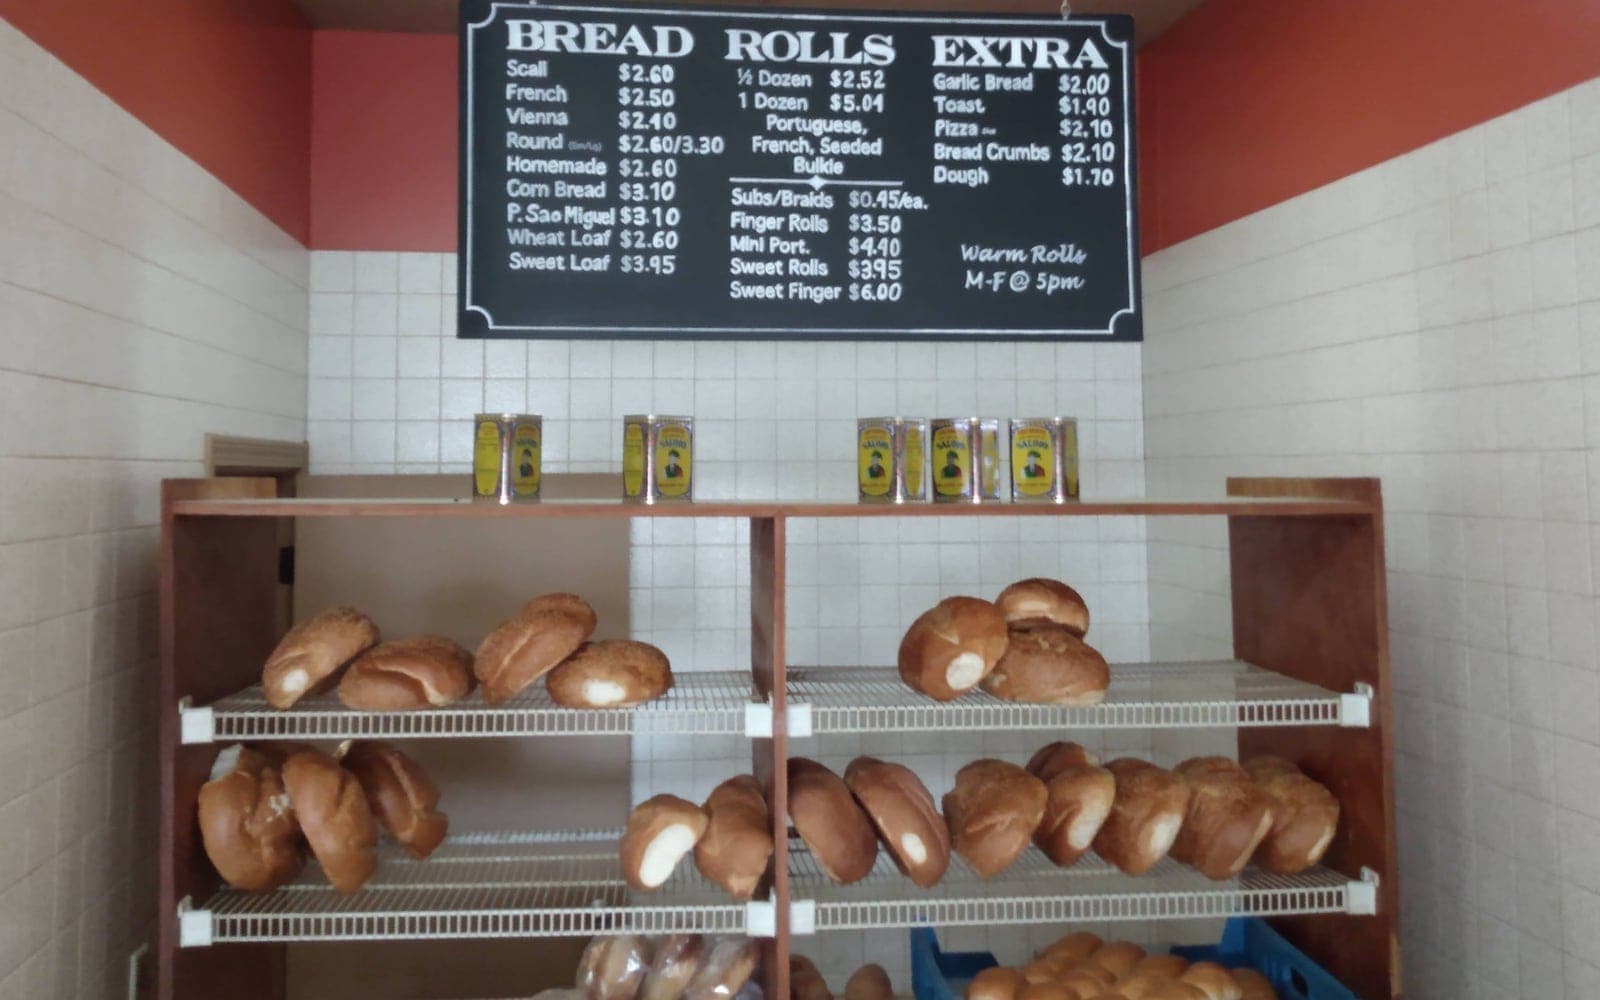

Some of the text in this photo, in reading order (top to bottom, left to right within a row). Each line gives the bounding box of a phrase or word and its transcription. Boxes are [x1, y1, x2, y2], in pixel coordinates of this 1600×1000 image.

[505, 19, 694, 57] BREAD
[724, 29, 896, 66] ROLLS
[931, 35, 1109, 69] EXTRA
[506, 59, 675, 83] Scall $2.60
[758, 70, 812, 88] Dozen
[830, 69, 886, 90] $2.52
[506, 83, 676, 107] French $2.50
[933, 73, 1110, 96] Garlic Bread $2.00
[738, 92, 885, 114] 1 Dozen $5.04
[933, 95, 1111, 116] Toast $1.90
[506, 108, 677, 131] Vienna $2.40
[766, 114, 868, 136] Portuguese,
[935, 119, 978, 137] Pizza
[1059, 118, 1113, 139] $2.10
[506, 131, 564, 150] Round
[618, 135, 725, 155] $2.60/3.30
[752, 135, 883, 156] French, Seeded
[933, 141, 1115, 164] Bread Crumbs $2.10
[506, 155, 678, 179] Homemade $2.60
[793, 156, 845, 175] Bulkie
[933, 165, 1115, 187] Dough $1.70
[506, 178, 676, 202] Corn Bread $3.10
[731, 188, 835, 209] Subs/Braids
[564, 205, 616, 231] Miguel
[619, 206, 681, 227] $3.10
[730, 212, 902, 234] Finger Rolls $3.50
[507, 228, 679, 250] Wheat Loaf $2.60
[730, 235, 901, 257] Mini Port. $4.40
[508, 252, 676, 275] Sweet Loaf $3.95
[960, 243, 1088, 264] Warm Rolls
[730, 258, 903, 280] Sweet Rolls $3.95
[729, 281, 903, 303] Sweet Finger $6.00
[1035, 271, 1085, 296] 5pm
